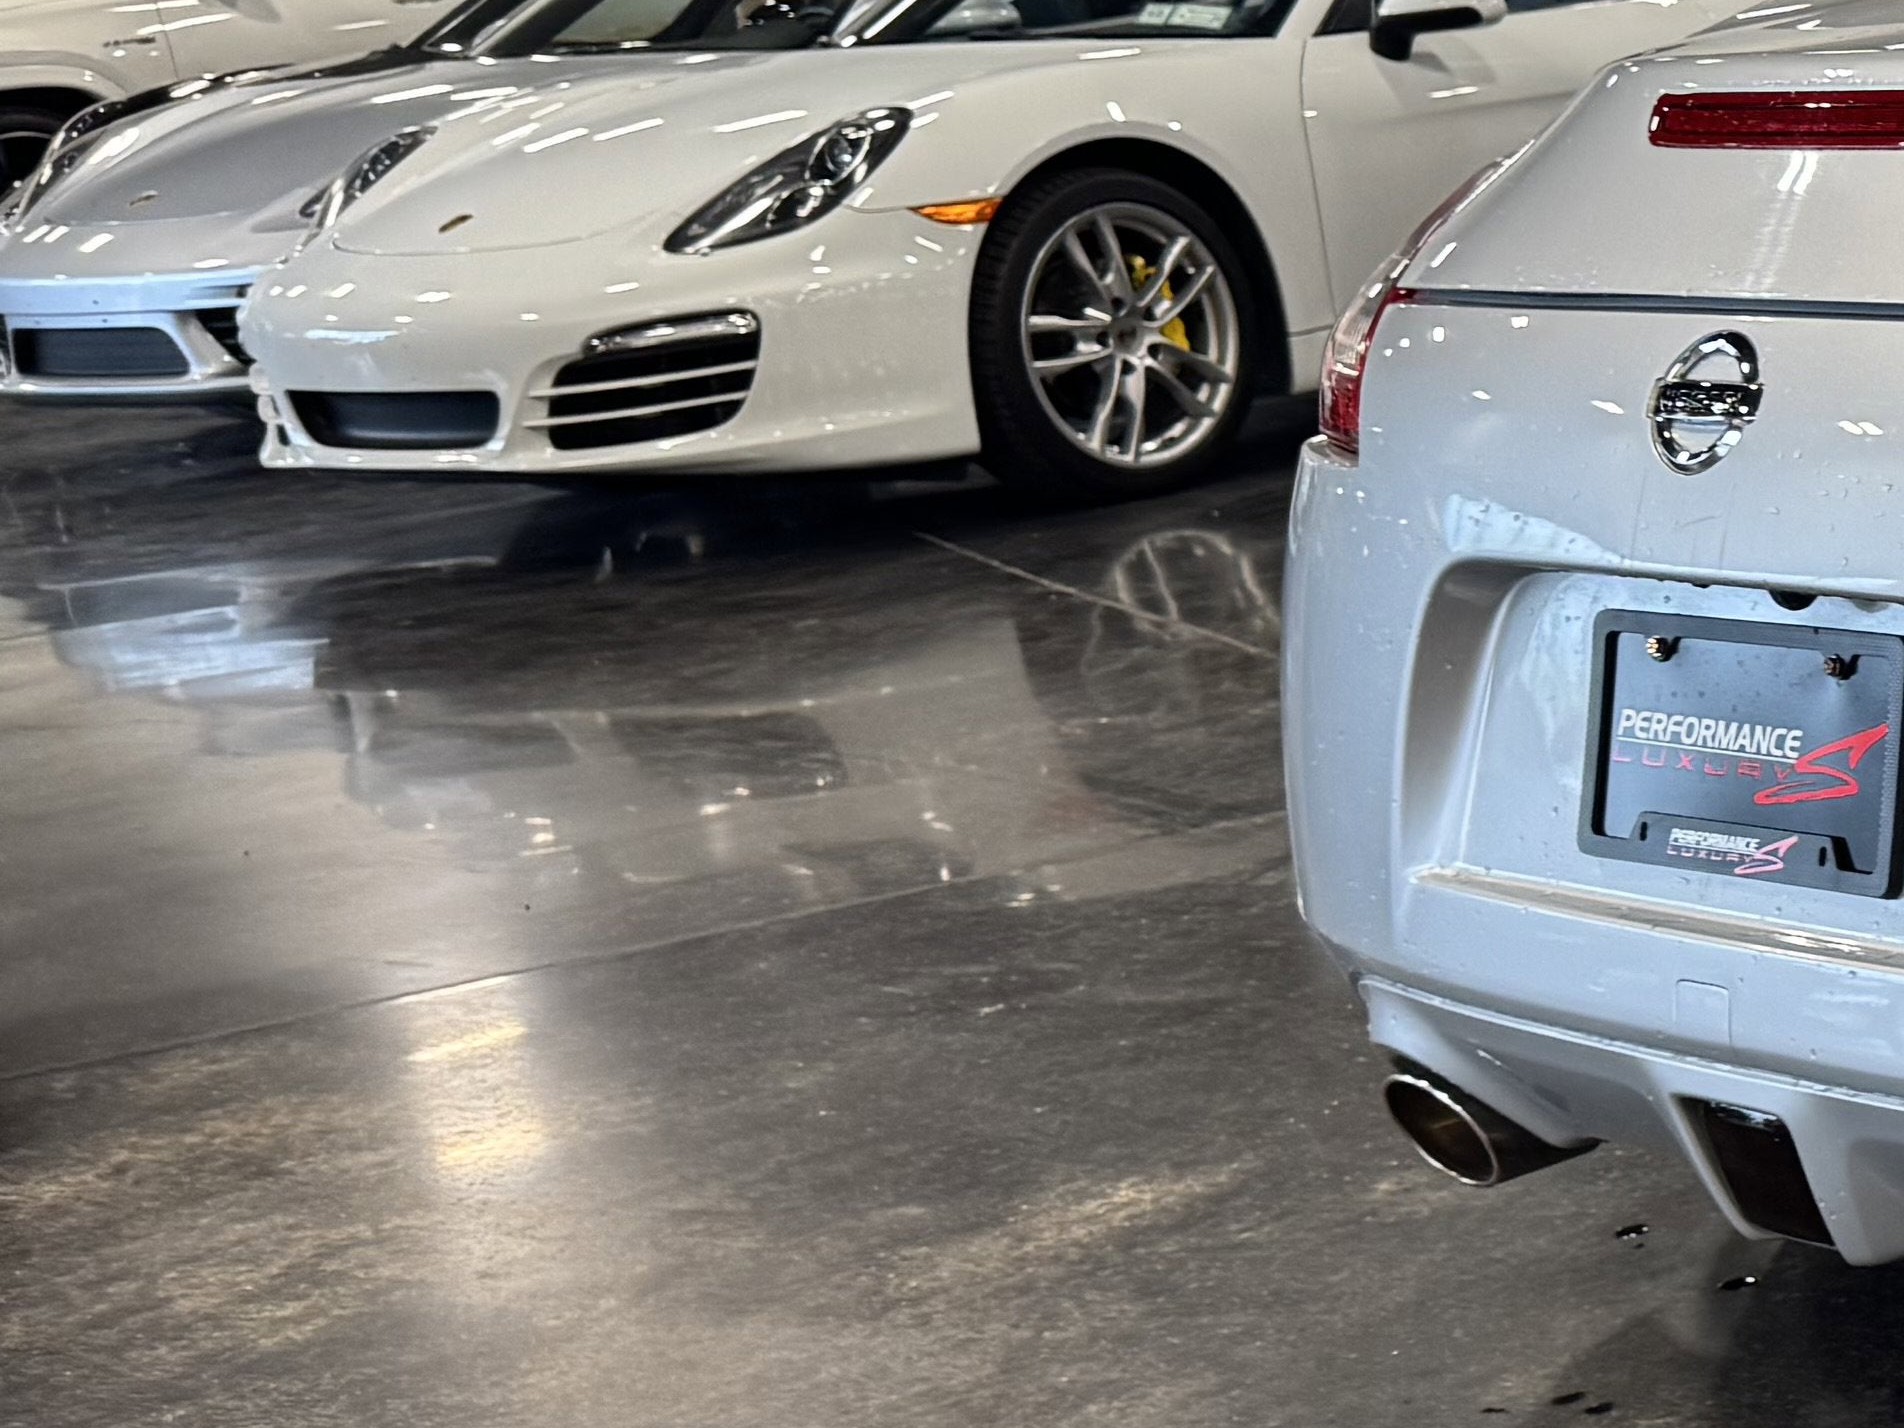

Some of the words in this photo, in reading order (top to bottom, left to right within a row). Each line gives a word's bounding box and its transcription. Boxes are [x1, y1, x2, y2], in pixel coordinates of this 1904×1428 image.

[1616, 707, 1804, 760] PERFORMANCE
[1611, 744, 1796, 782] LUXURY
[1669, 827, 1761, 853] PERFORMANCE
